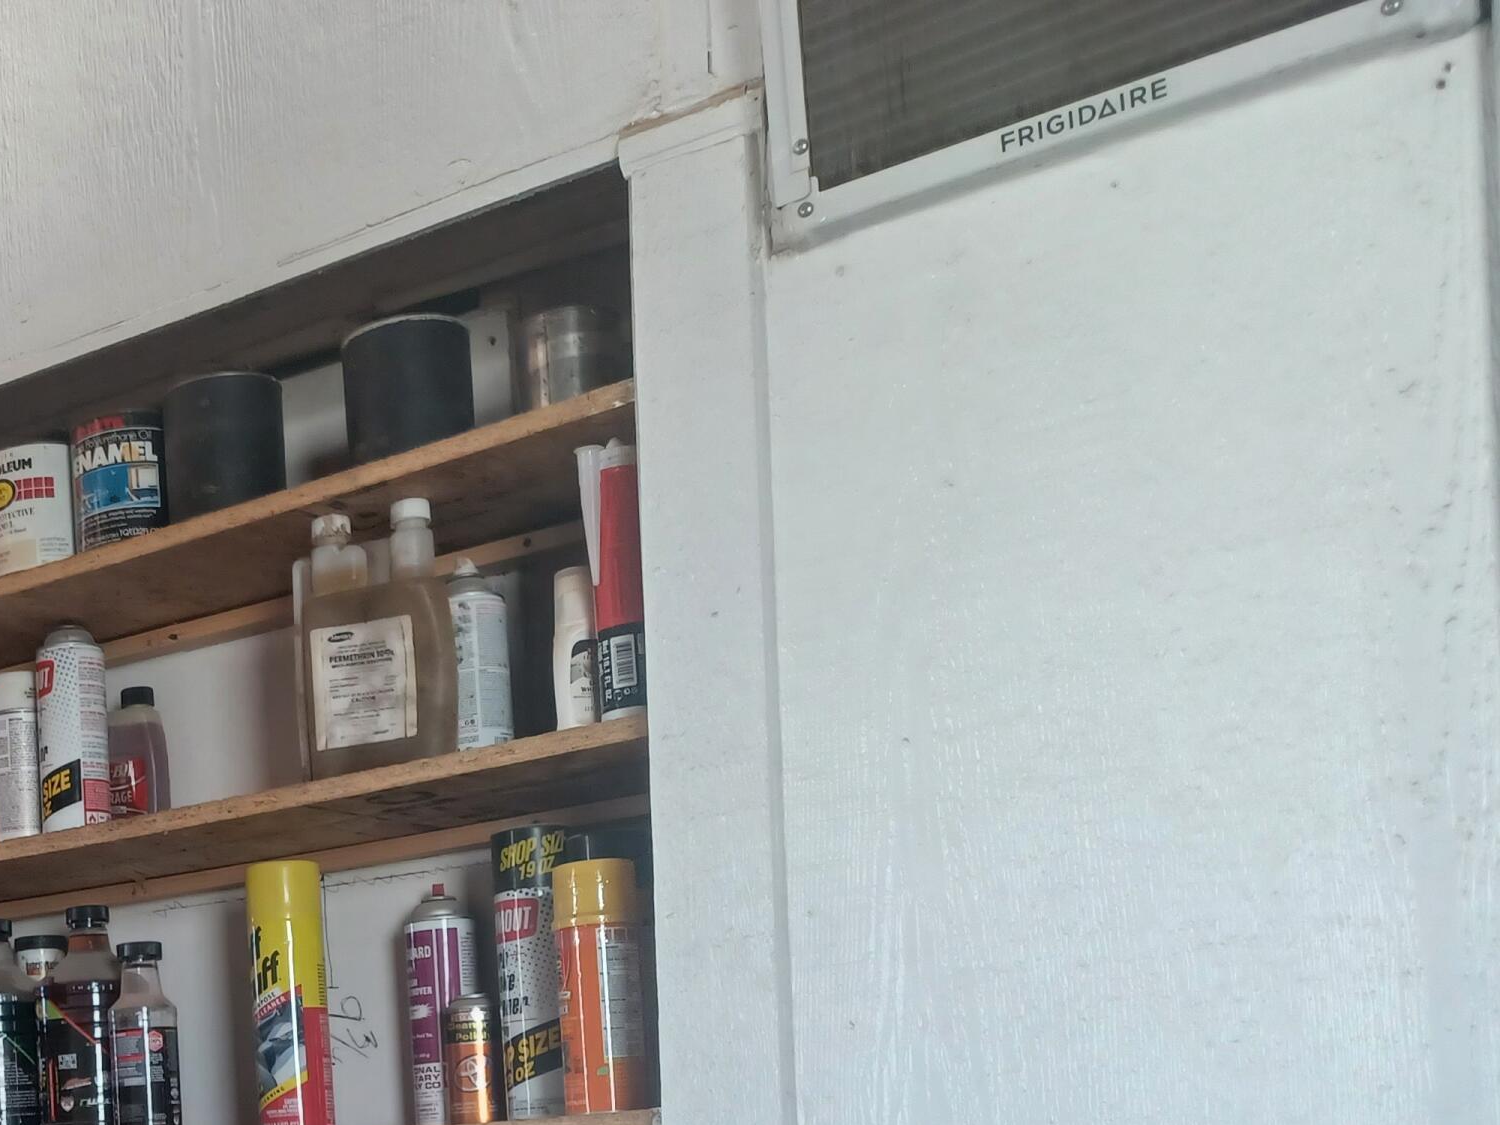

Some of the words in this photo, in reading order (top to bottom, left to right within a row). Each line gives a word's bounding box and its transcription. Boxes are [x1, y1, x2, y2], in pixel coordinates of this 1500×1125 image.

[1000, 78, 1168, 153] FRIGIDAIRE
[500, 836, 538, 873] SHOP
[519, 860, 536, 881] 19
[538, 855, 556, 876] OZ
[517, 1024, 561, 1063] SIZE
[425, 1081, 441, 1090] CO
[515, 1060, 535, 1082] OZ
